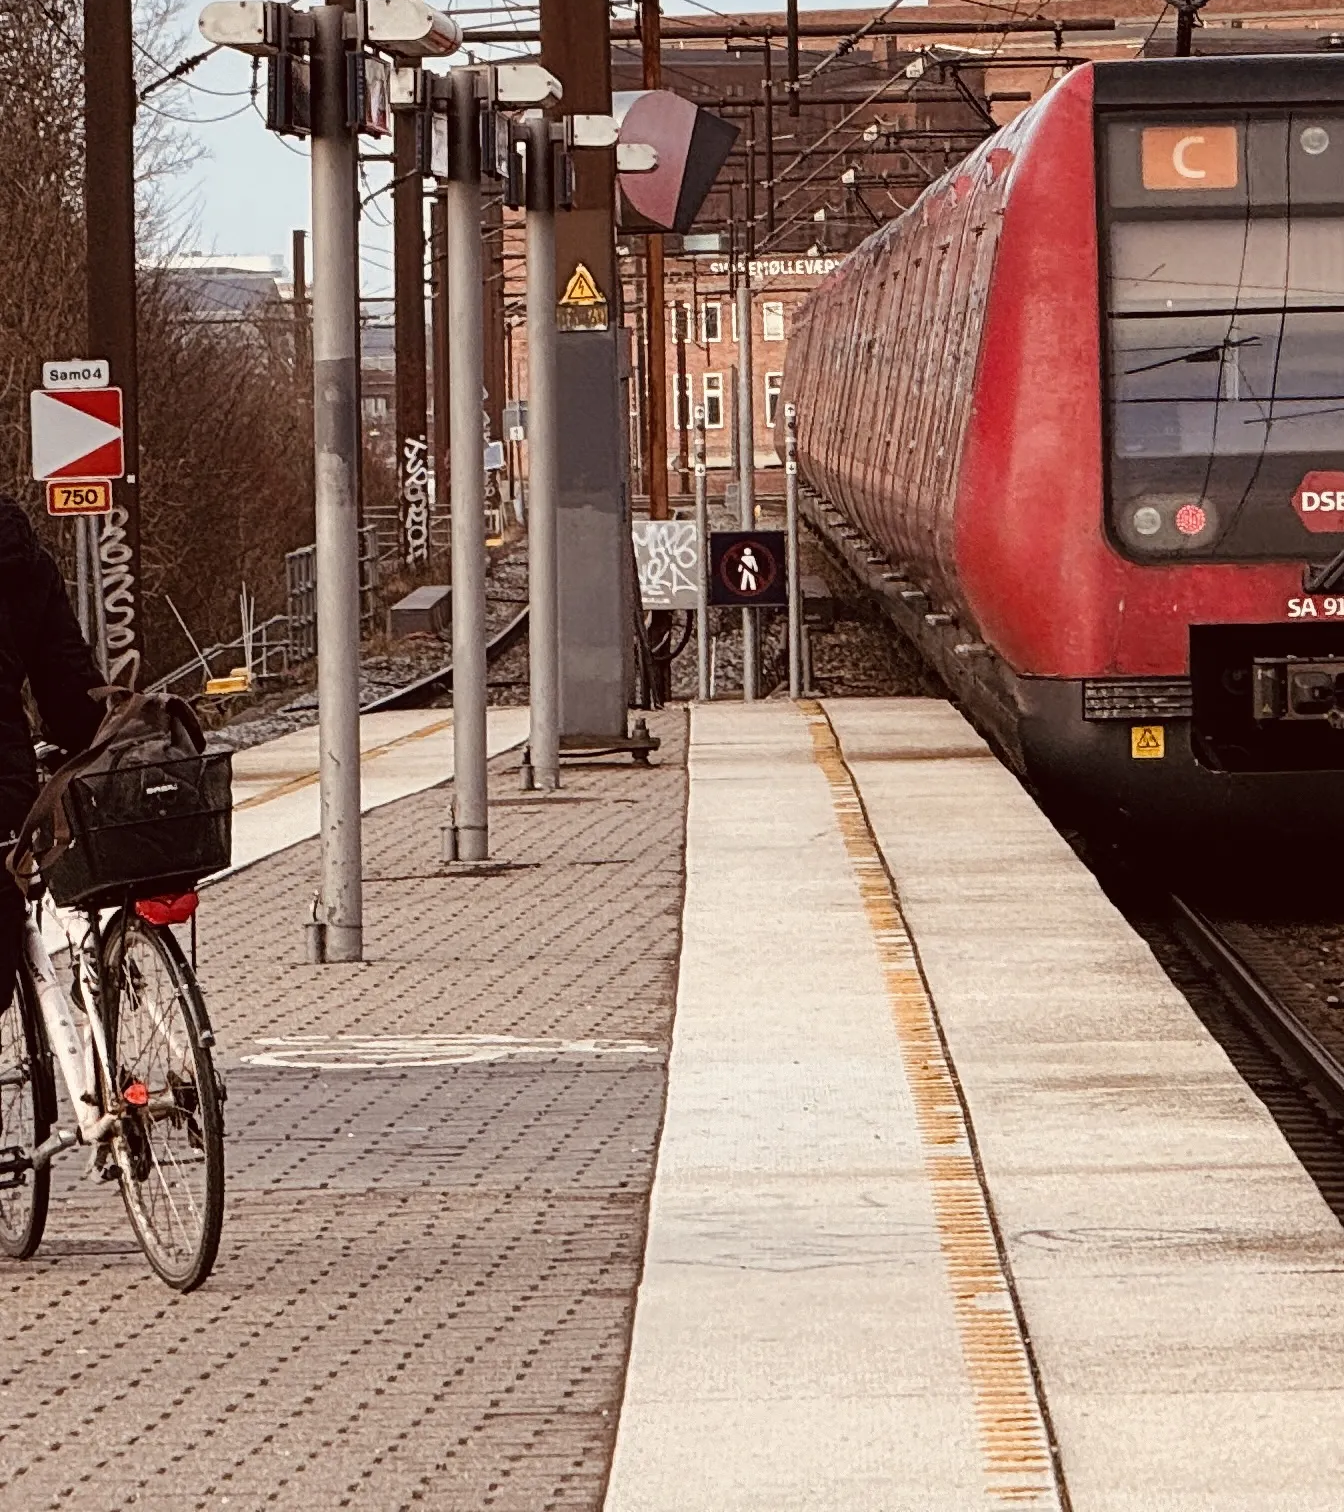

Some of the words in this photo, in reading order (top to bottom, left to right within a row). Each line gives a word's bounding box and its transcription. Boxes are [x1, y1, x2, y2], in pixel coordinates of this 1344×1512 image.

[1171, 135, 1207, 179] C
[49, 367, 102, 381] Sam04
[60, 488, 99, 506] 750
[1287, 597, 1318, 618] SA
